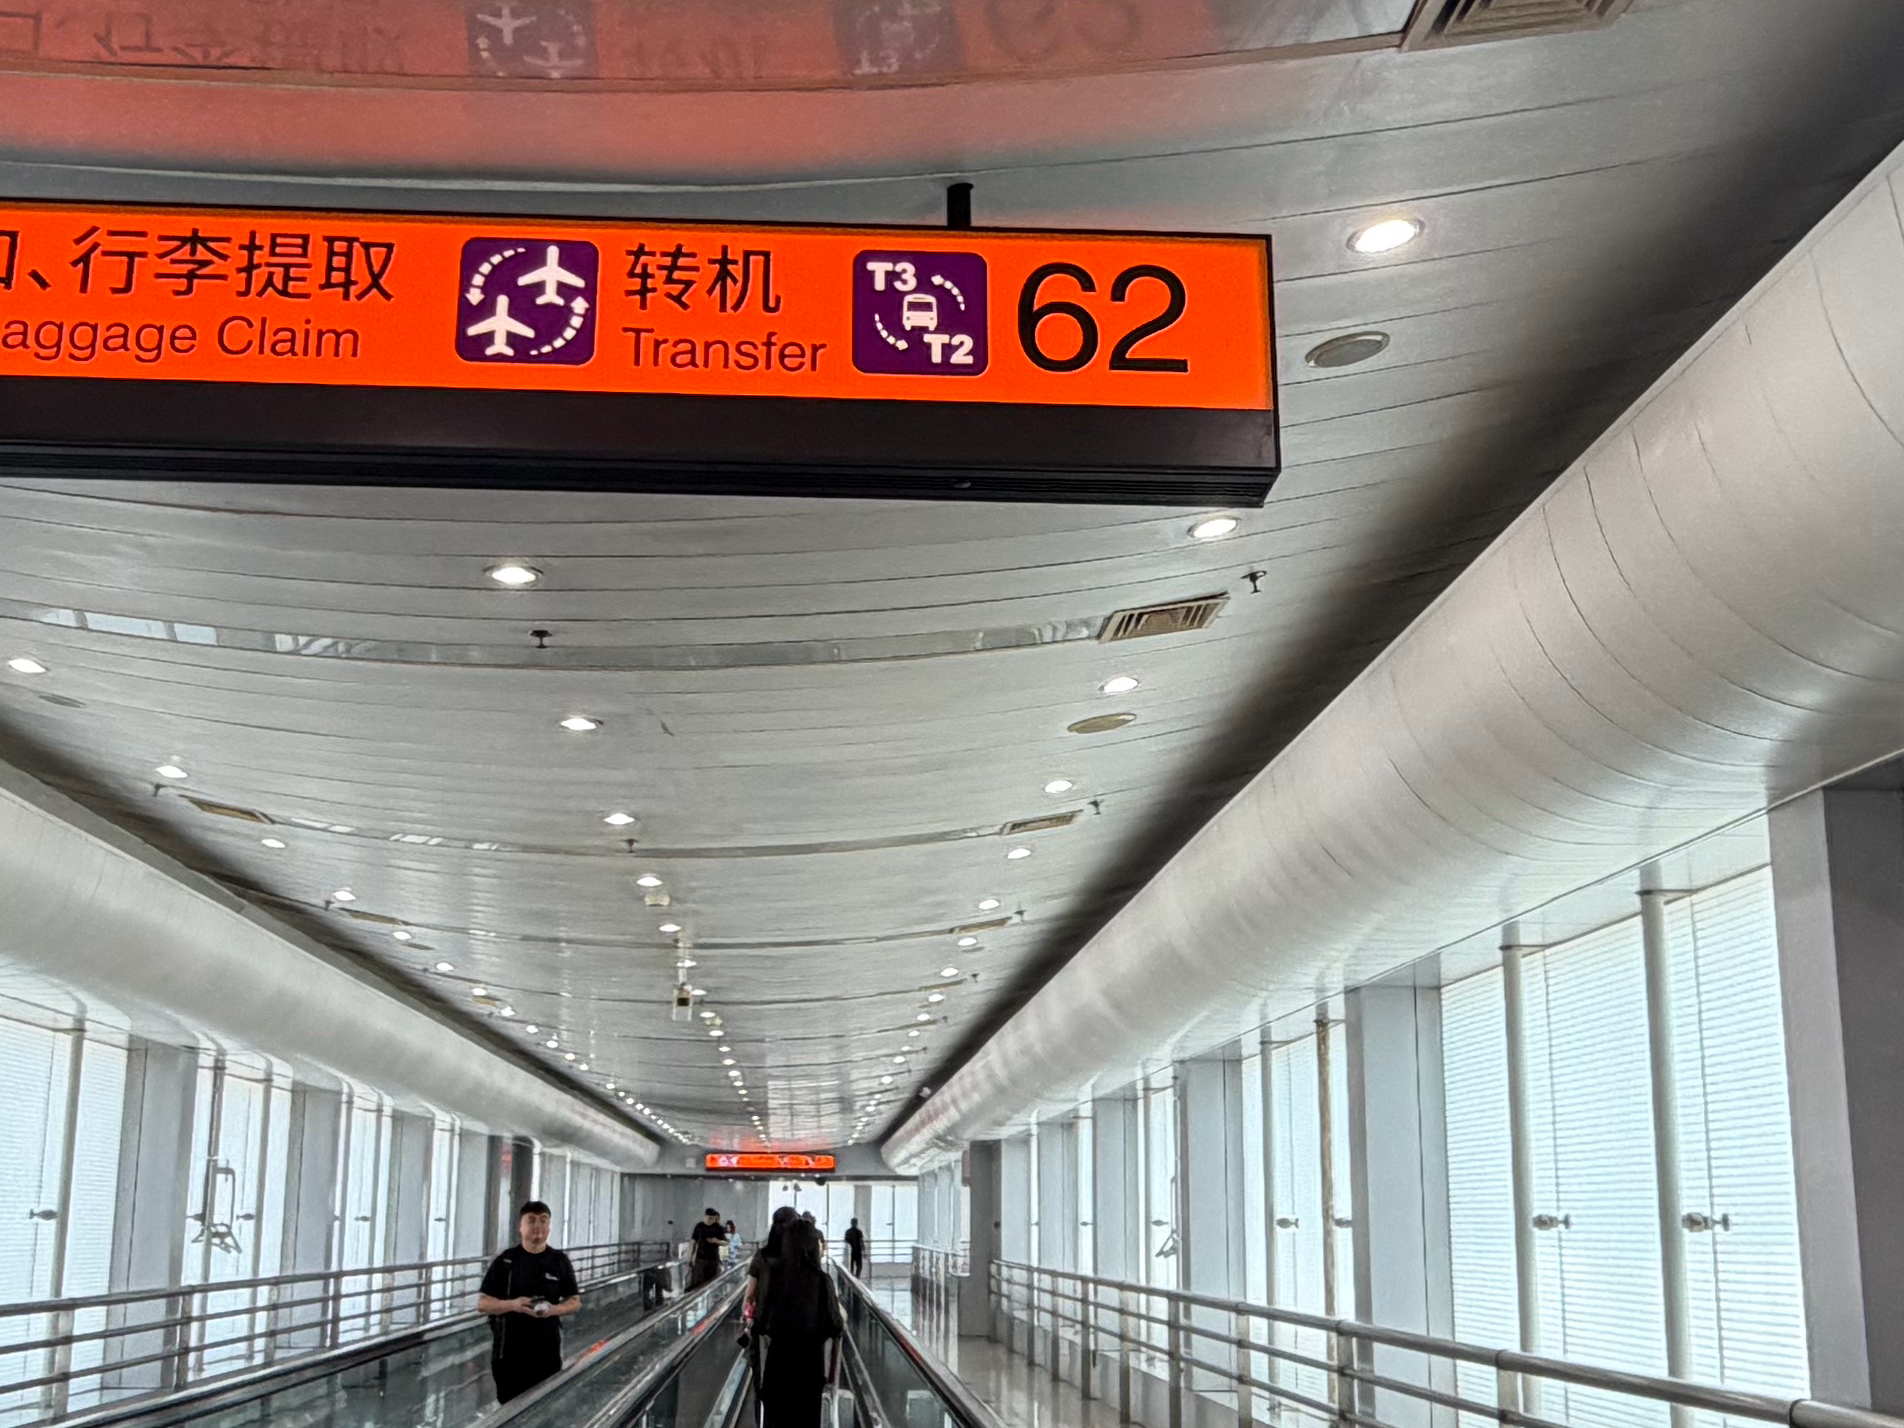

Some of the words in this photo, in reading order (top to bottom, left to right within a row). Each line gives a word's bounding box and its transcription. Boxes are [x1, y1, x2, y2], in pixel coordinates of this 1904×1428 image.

[624, 243, 782, 314] 转机
[866, 261, 918, 292] T3
[217, 316, 360, 359] Claim
[1017, 261, 1189, 373] 62
[622, 327, 828, 373] Transfer
[923, 333, 974, 364] T2
